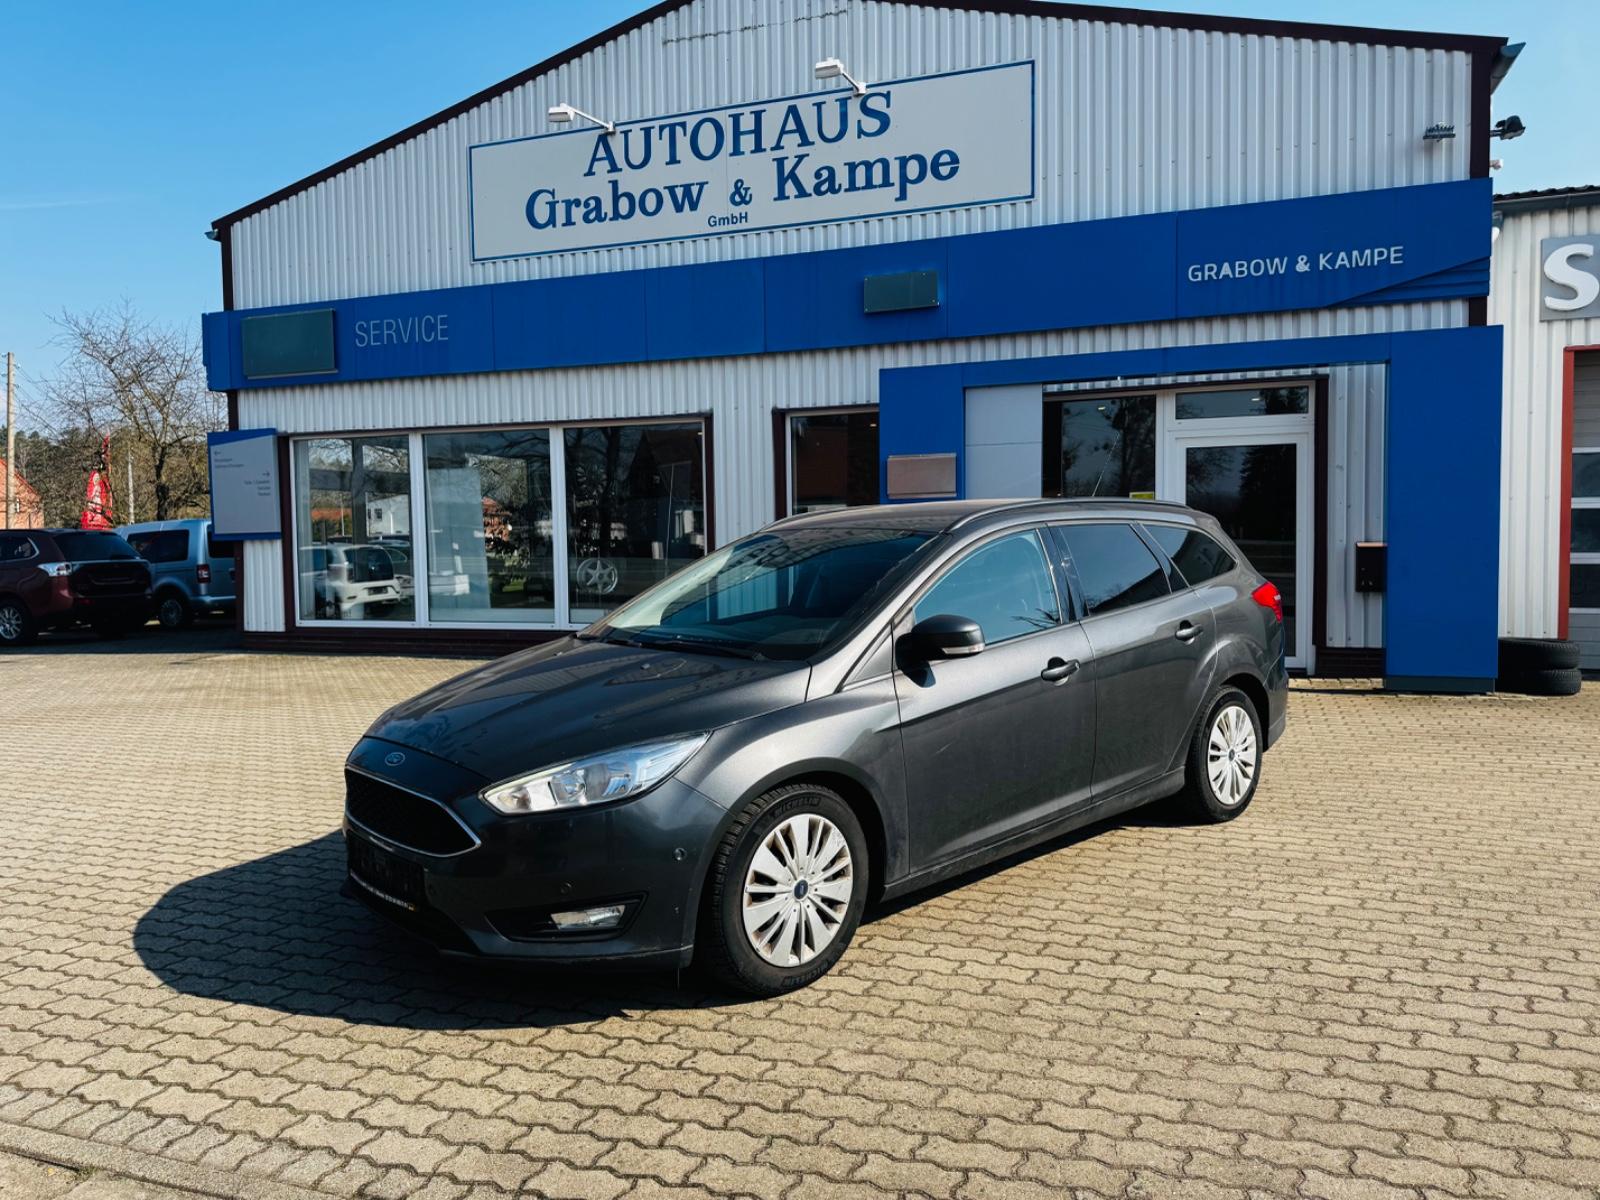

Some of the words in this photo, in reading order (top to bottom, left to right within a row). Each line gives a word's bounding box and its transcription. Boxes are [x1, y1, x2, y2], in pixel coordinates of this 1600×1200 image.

[583, 91, 892, 178] AUTOHAUS
[525, 179, 709, 230] Grabow
[729, 179, 753, 207] &
[772, 148, 960, 202] Kampe
[707, 211, 749, 228] GmbH
[1187, 256, 1289, 283] GRABOW
[1295, 254, 1312, 273] &
[1318, 246, 1405, 272] KAMPE
[354, 314, 449, 348] SERVICE
